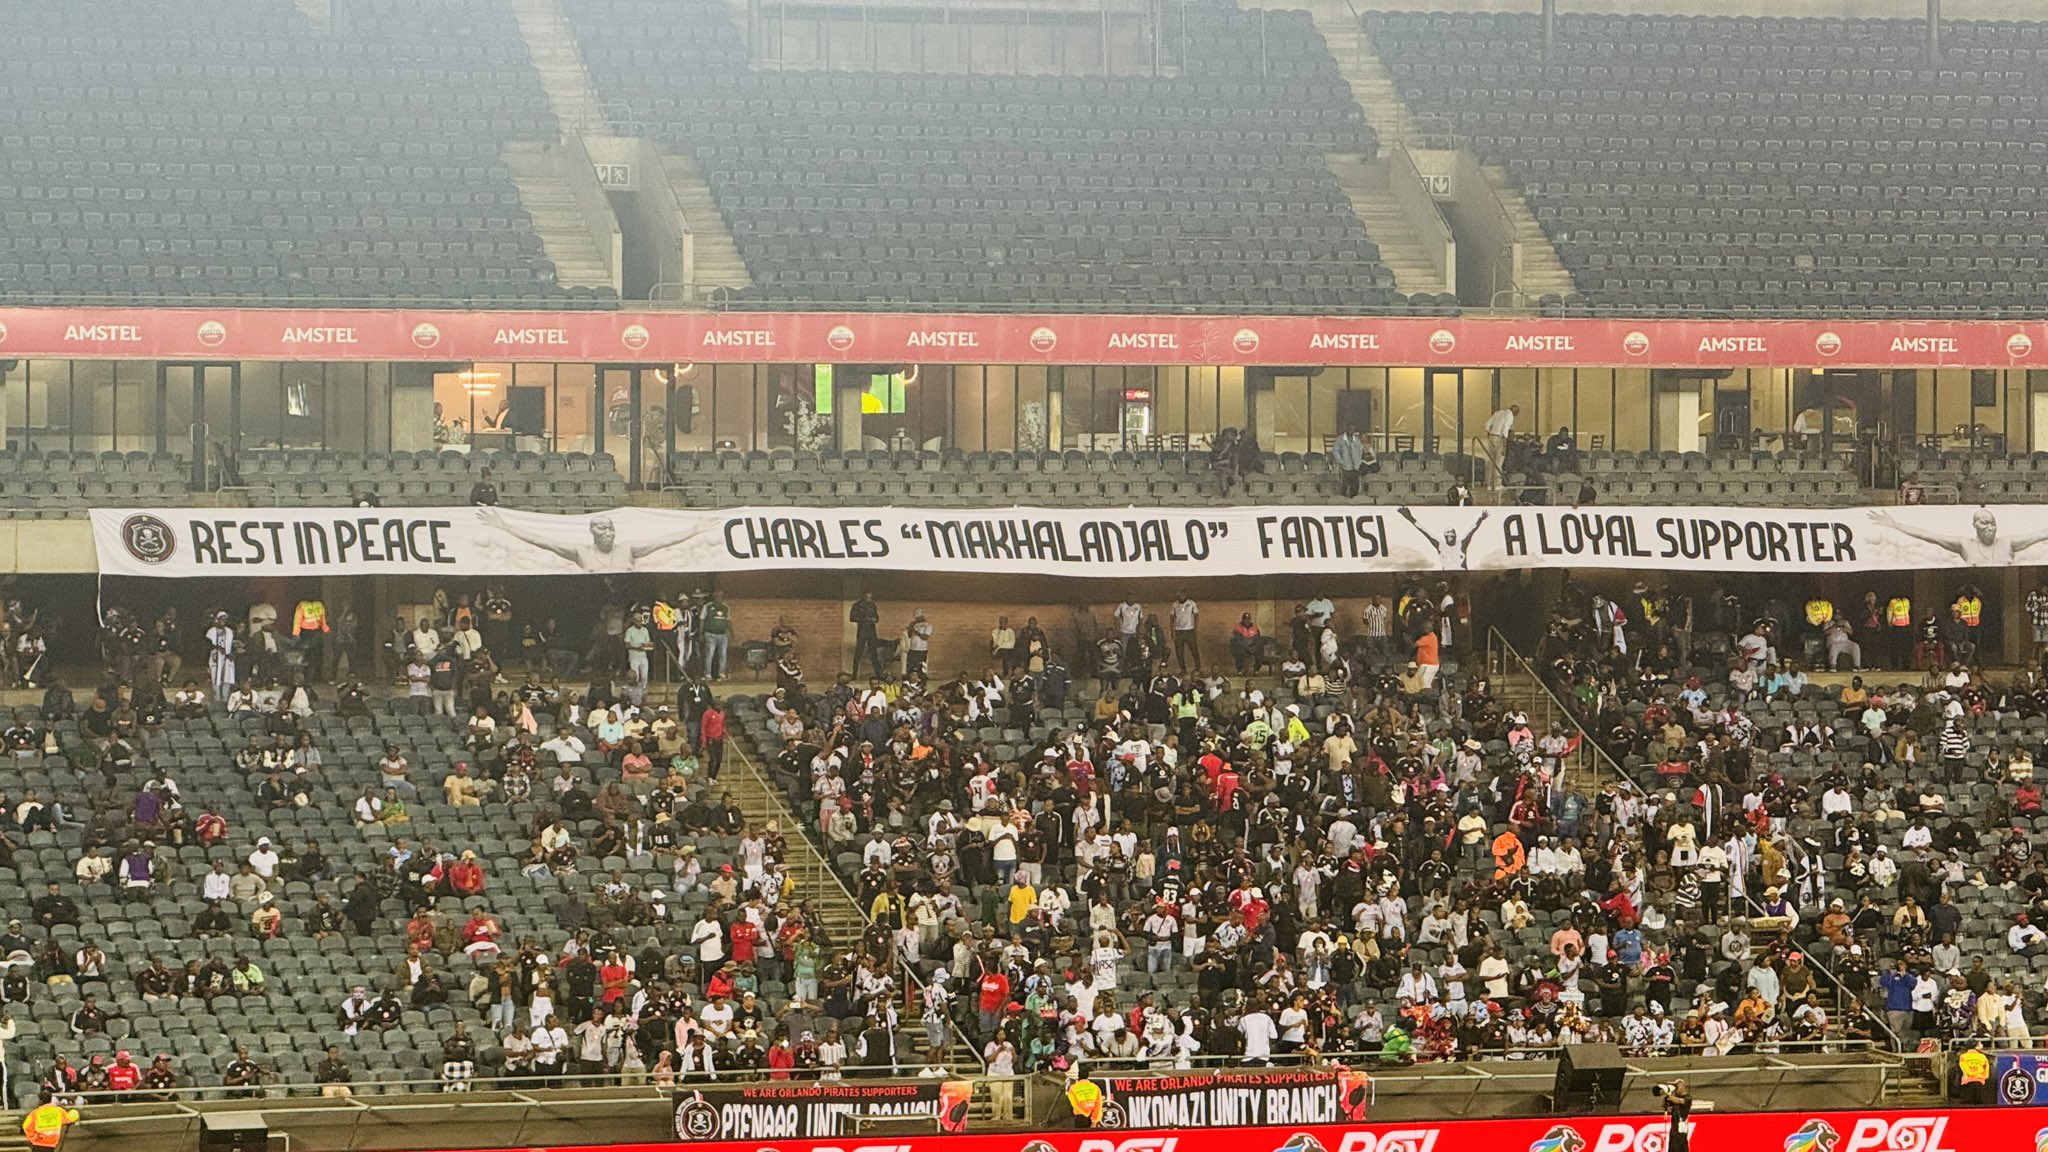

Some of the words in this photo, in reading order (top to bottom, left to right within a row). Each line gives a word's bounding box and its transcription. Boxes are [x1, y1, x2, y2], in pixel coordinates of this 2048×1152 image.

[65, 325, 141, 340] AMSTEL
[282, 328, 357, 343] AMSTEL
[495, 329, 568, 344] AMSTEL
[703, 331, 775, 346] AMSTEL
[907, 332, 978, 347] AMSTEL
[1109, 334, 1178, 349] AMSTEL
[1310, 334, 1379, 350] AMSTEL
[1505, 336, 1574, 351] AMSTEL
[1699, 338, 1766, 352] AMSTEL
[1891, 338, 1958, 353] AMSTEL
[189, 519, 285, 564] REST
[293, 521, 331, 564] IN
[333, 518, 456, 563] PEACE
[724, 517, 890, 559] CHARLES
[1256, 515, 1389, 559] FANTISI
[1503, 514, 1528, 556] A
[1536, 513, 1652, 557] LOYAL
[1655, 517, 1857, 562] SUPPORTER
[1163, 888, 1178, 905] 83
[1115, 1079, 1132, 1091] WE
[1135, 1078, 1157, 1091] ARE
[1160, 1075, 1214, 1090] ORLANDO
[743, 1088, 757, 1097] WE
[760, 1088, 777, 1097] ARE
[779, 1087, 821, 1097] ORLANDO
[824, 1087, 860, 1097] PIRATES
[861, 1086, 917, 1096] SUPPORTERS
[1128, 1090, 1206, 1128] NKOMAZI
[1209, 1087, 1261, 1126] UNITY
[1266, 1084, 1337, 1124] BRANCH
[1845, 1116, 1956, 1152] PSL
